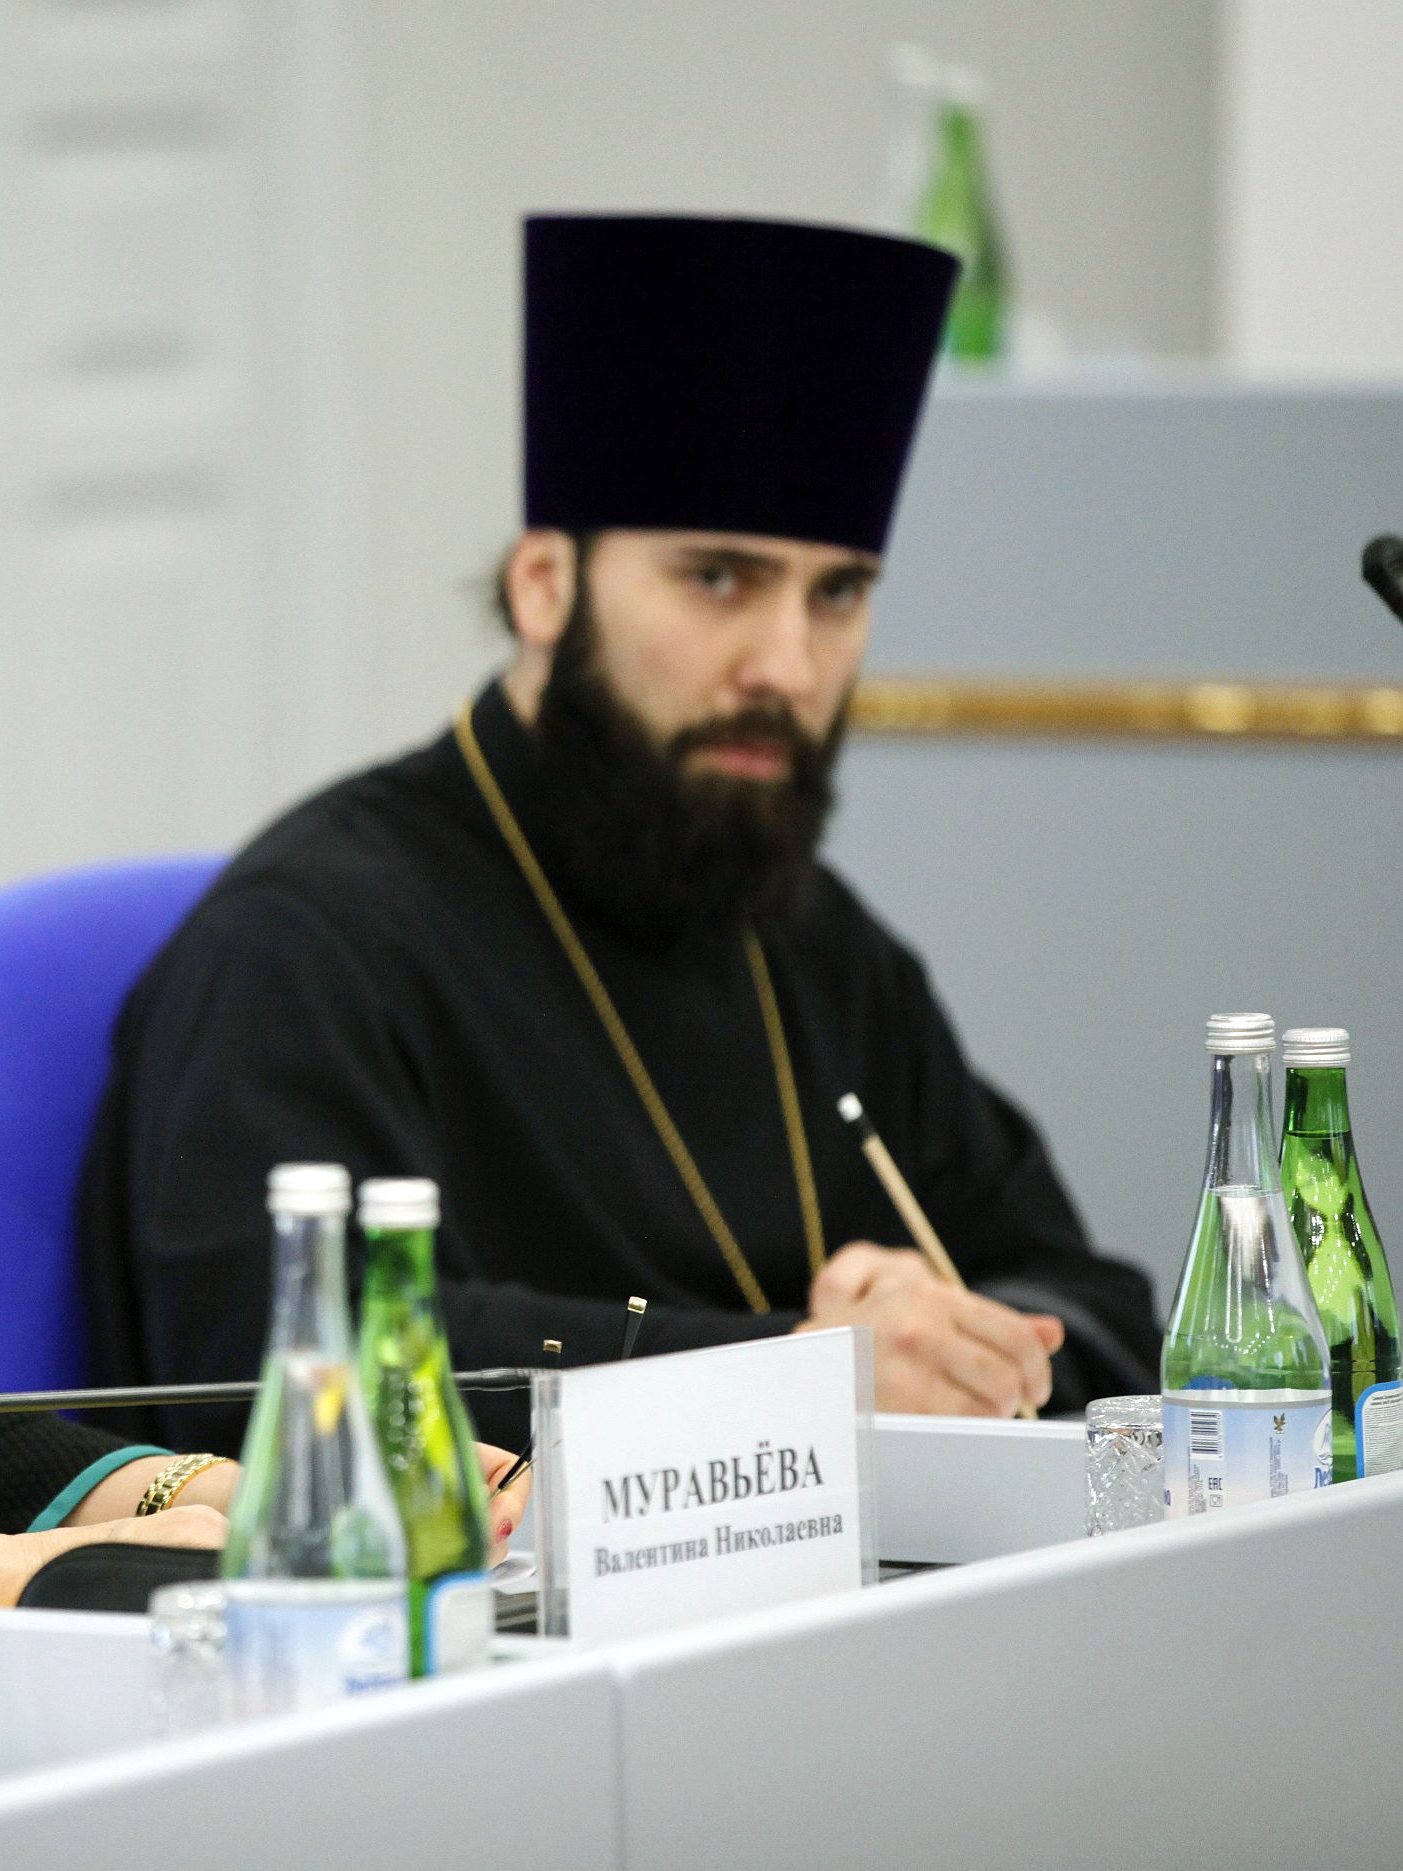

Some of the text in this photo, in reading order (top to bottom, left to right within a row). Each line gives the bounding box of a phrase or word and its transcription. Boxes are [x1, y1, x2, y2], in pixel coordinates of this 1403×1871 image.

[602, 1440, 825, 1523] МУРАВЬЁВА
[594, 1513, 844, 1578] Валентина Николаевна
